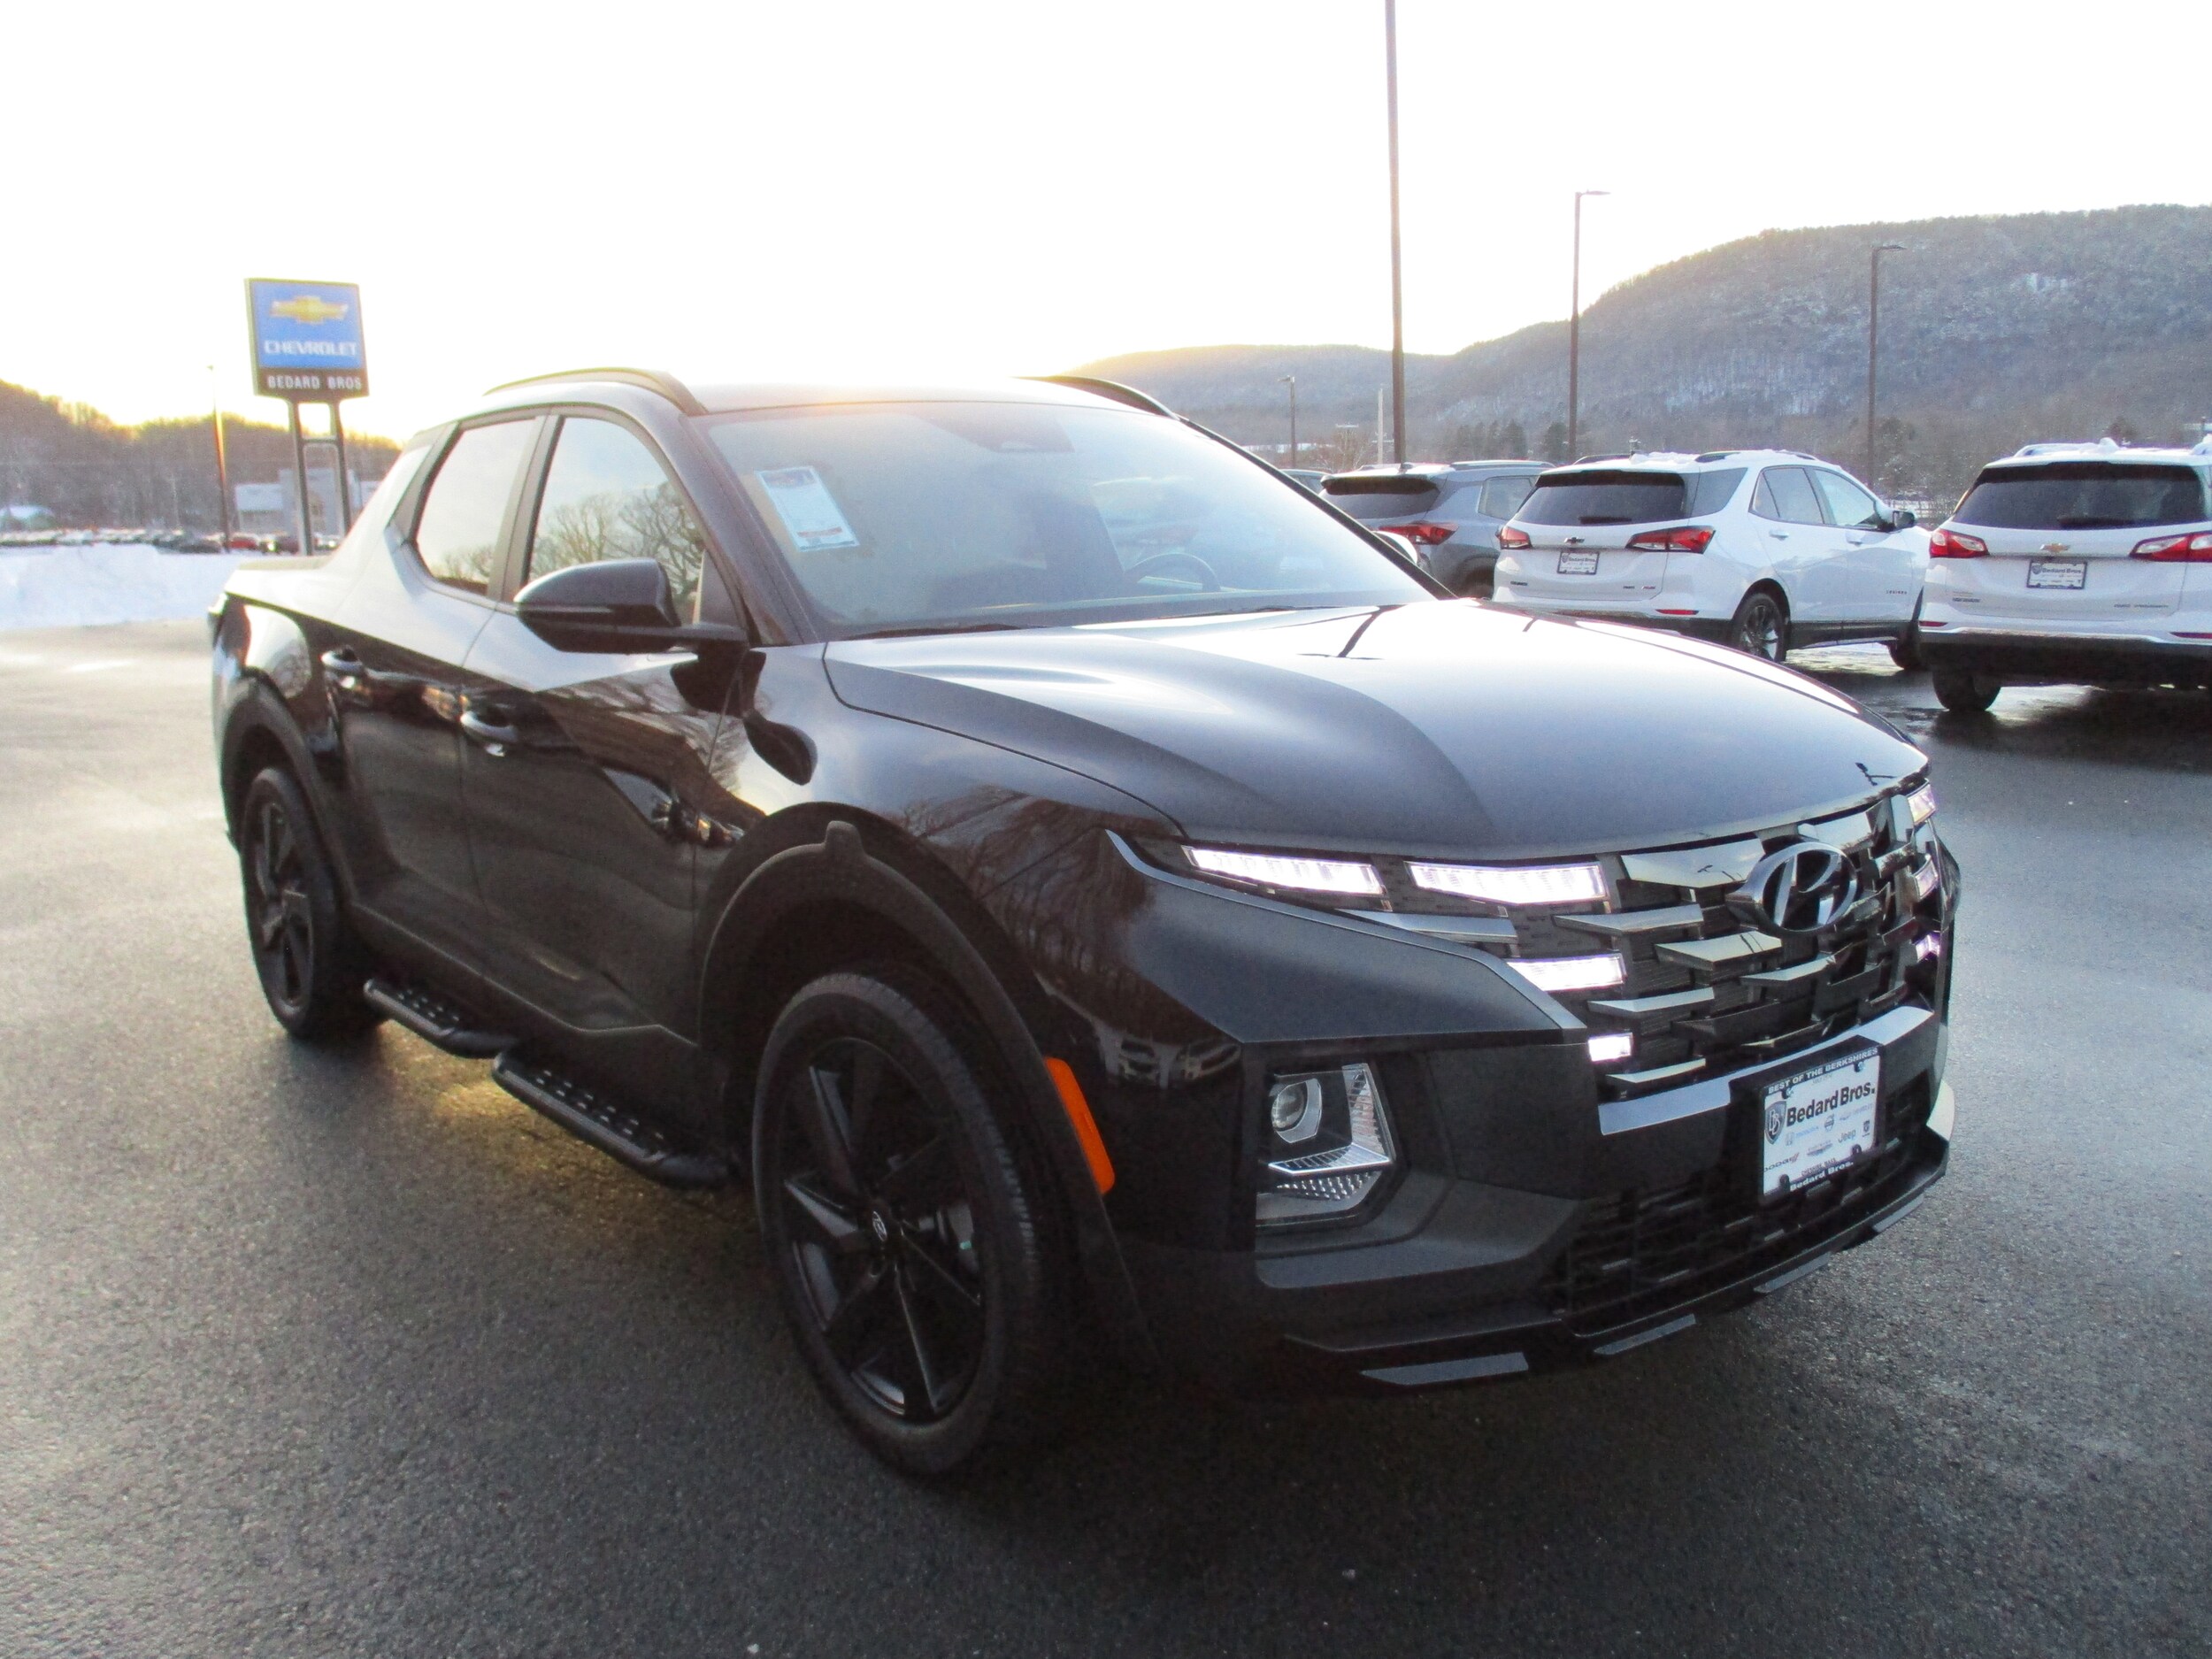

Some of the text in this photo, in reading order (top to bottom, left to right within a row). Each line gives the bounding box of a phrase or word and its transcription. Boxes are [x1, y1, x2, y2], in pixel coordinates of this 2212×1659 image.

[265, 340, 357, 356] CHEVROLET
[267, 375, 362, 390] BEDARD BROS
[1768, 1080, 1790, 1094] BEST
[1792, 1074, 1804, 1084] OF
[1806, 1068, 1823, 1079] THE
[1825, 1048, 1878, 1071] BERKSHIRES
[1786, 1082, 1875, 1127] Bedard Bros.
[1790, 1170, 1825, 1192] Bedard
